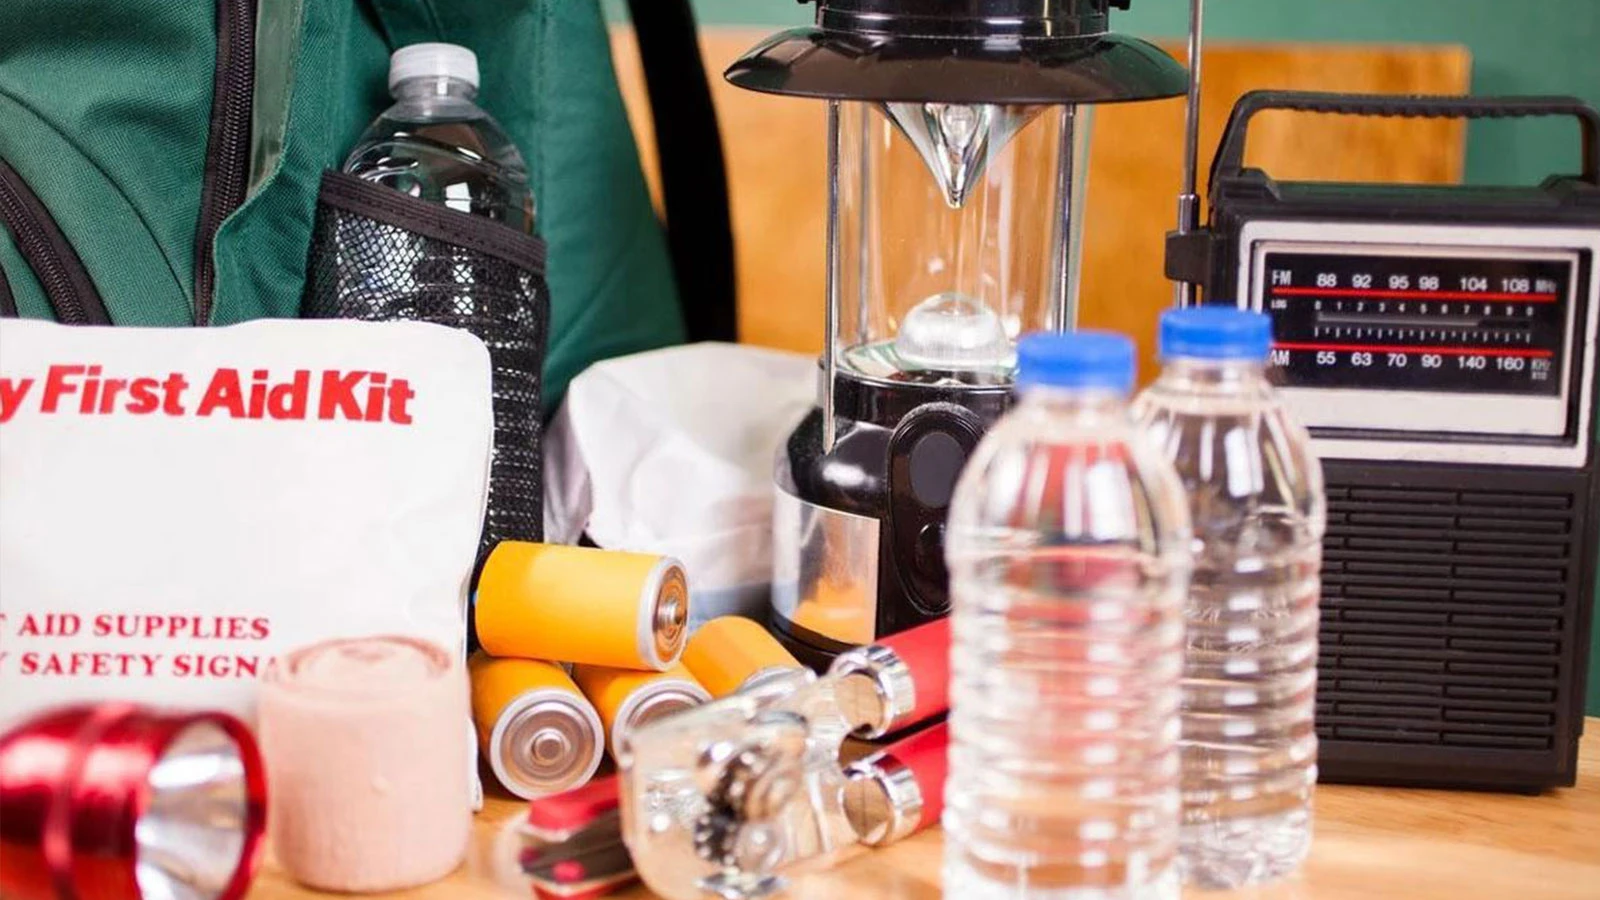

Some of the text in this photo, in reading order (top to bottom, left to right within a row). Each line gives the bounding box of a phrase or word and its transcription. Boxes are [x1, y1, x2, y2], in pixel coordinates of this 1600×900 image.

[1271, 269, 1292, 285] FM
[1316, 272, 1337, 287] 88
[1351, 273, 1372, 288] 92
[1388, 275, 1410, 290] 95
[1418, 276, 1440, 290] 98
[1460, 277, 1488, 291] 104
[1501, 278, 1530, 292] 108
[1270, 349, 1290, 367] AM
[1316, 351, 1337, 365] 55
[1350, 352, 1373, 366] 63
[1387, 353, 1408, 367] 70
[1421, 354, 1443, 368] 90
[1458, 355, 1487, 370] 140
[1496, 356, 1525, 371] 160
[40, 364, 190, 417] First
[196, 367, 311, 420] Aid
[318, 369, 416, 426] Kit
[18, 612, 82, 637] AID
[93, 614, 271, 641] SUPPLIES
[20, 651, 163, 677] SAFETY
